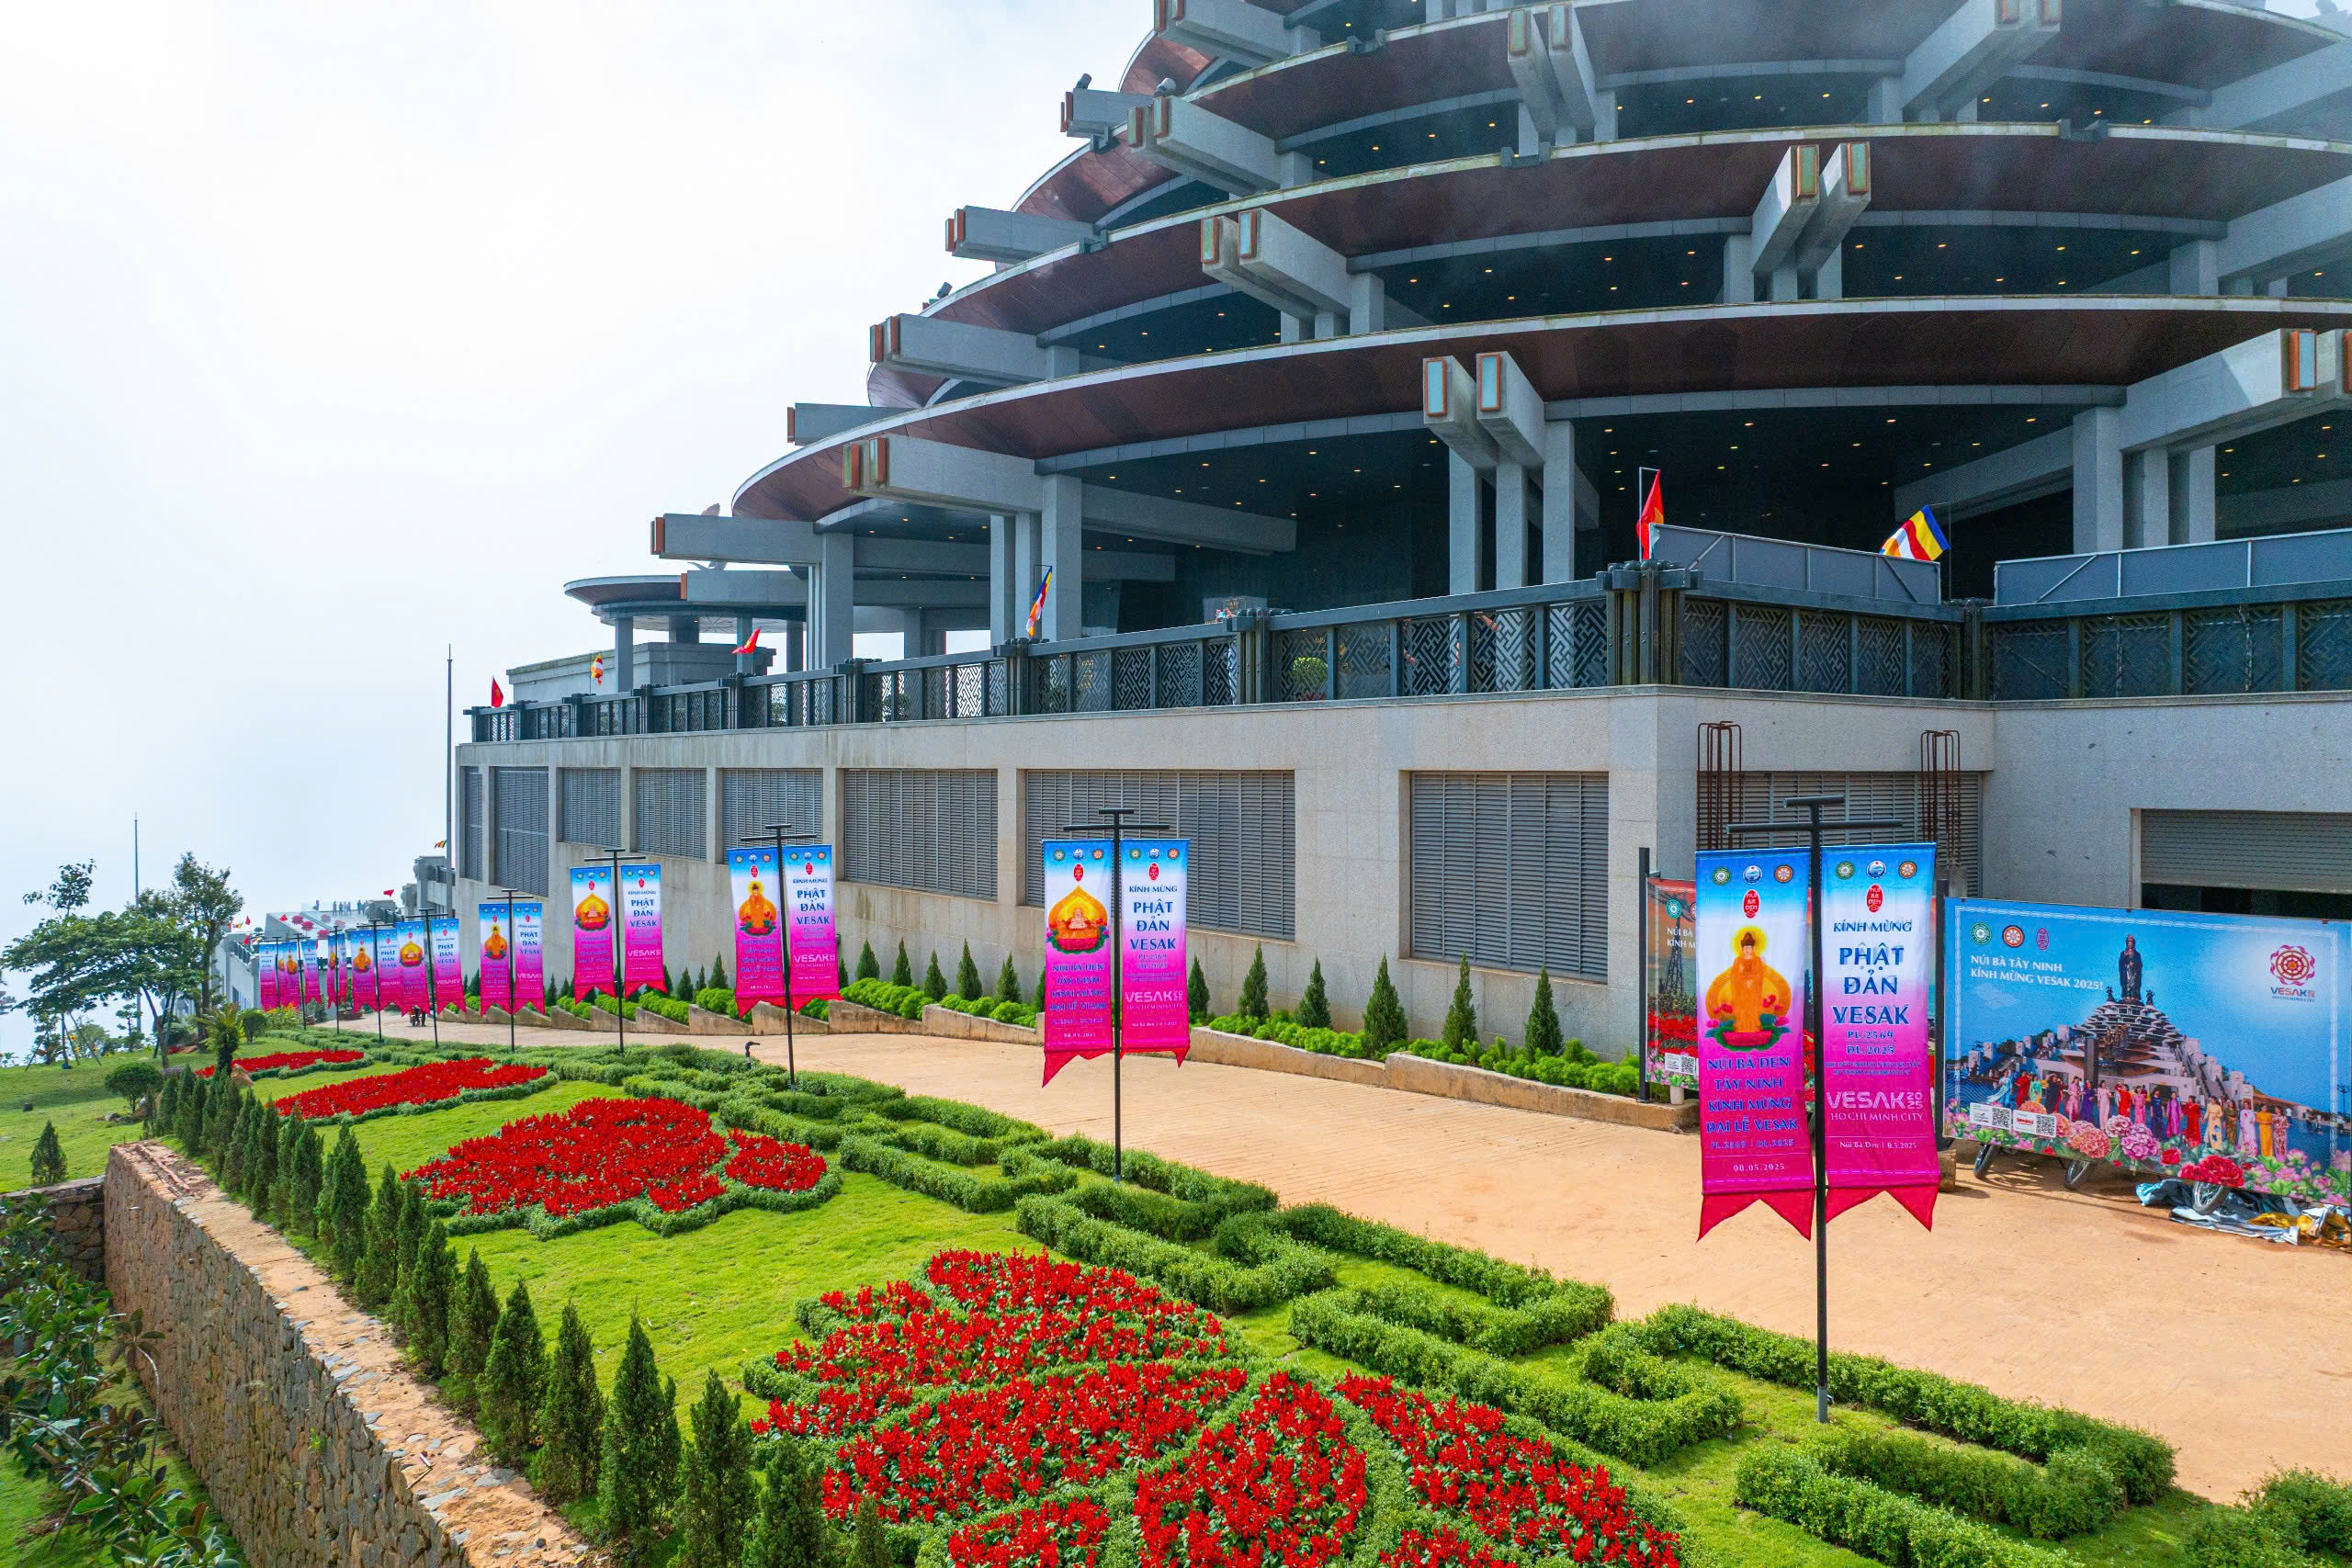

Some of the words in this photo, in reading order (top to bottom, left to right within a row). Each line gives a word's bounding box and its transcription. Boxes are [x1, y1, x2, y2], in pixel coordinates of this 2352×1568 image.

[797, 887, 825, 900] PHẬT
[1129, 885, 1149, 893] KÍNH
[1133, 898, 1173, 917] PHẬT
[797, 916, 830, 925] VESAK
[1136, 916, 1170, 931] ĐẢN
[1833, 919, 1866, 932] KÍNH
[1871, 919, 1912, 932] MỪNG
[1667, 927, 1680, 936] NÚI
[1683, 928, 1693, 937] BÀ
[1130, 938, 1176, 950] VESAK
[1667, 938, 1686, 948] KÍNH
[628, 949, 655, 957] VESAK
[794, 953, 829, 964] VESAK
[1839, 942, 1904, 971] PHẬT
[1971, 953, 1989, 965] NÚI
[1993, 955, 2007, 967] BÀ
[2009, 957, 2030, 969] TÂY
[2032, 962, 2063, 973] NINH
[1844, 969, 1897, 994] ĐẢN
[1971, 966, 1997, 978] KÍNH
[2000, 970, 2034, 983] MỪNG
[2037, 975, 2070, 987] VESAK
[2074, 978, 2103, 990] 2025!
[1125, 991, 1172, 1002] VESAK
[2271, 987, 2307, 997] VESAK
[1832, 1006, 1909, 1024] VESAK
[1848, 1031, 1894, 1039] PL.2569
[1707, 1056, 1733, 1070] NÚI
[1736, 1055, 1755, 1069] BÀ
[1715, 1076, 1741, 1090] TÂY
[1746, 1077, 1782, 1089] NINH
[1708, 1099, 1743, 1111] KÍNH
[1826, 1091, 1905, 1109] VESAK
[1830, 1112, 1846, 1121] HO
[1848, 1112, 1866, 1121] CHI
[1754, 1118, 1798, 1132] VESAK
[1734, 1163, 1785, 1172] 08.05.2025
